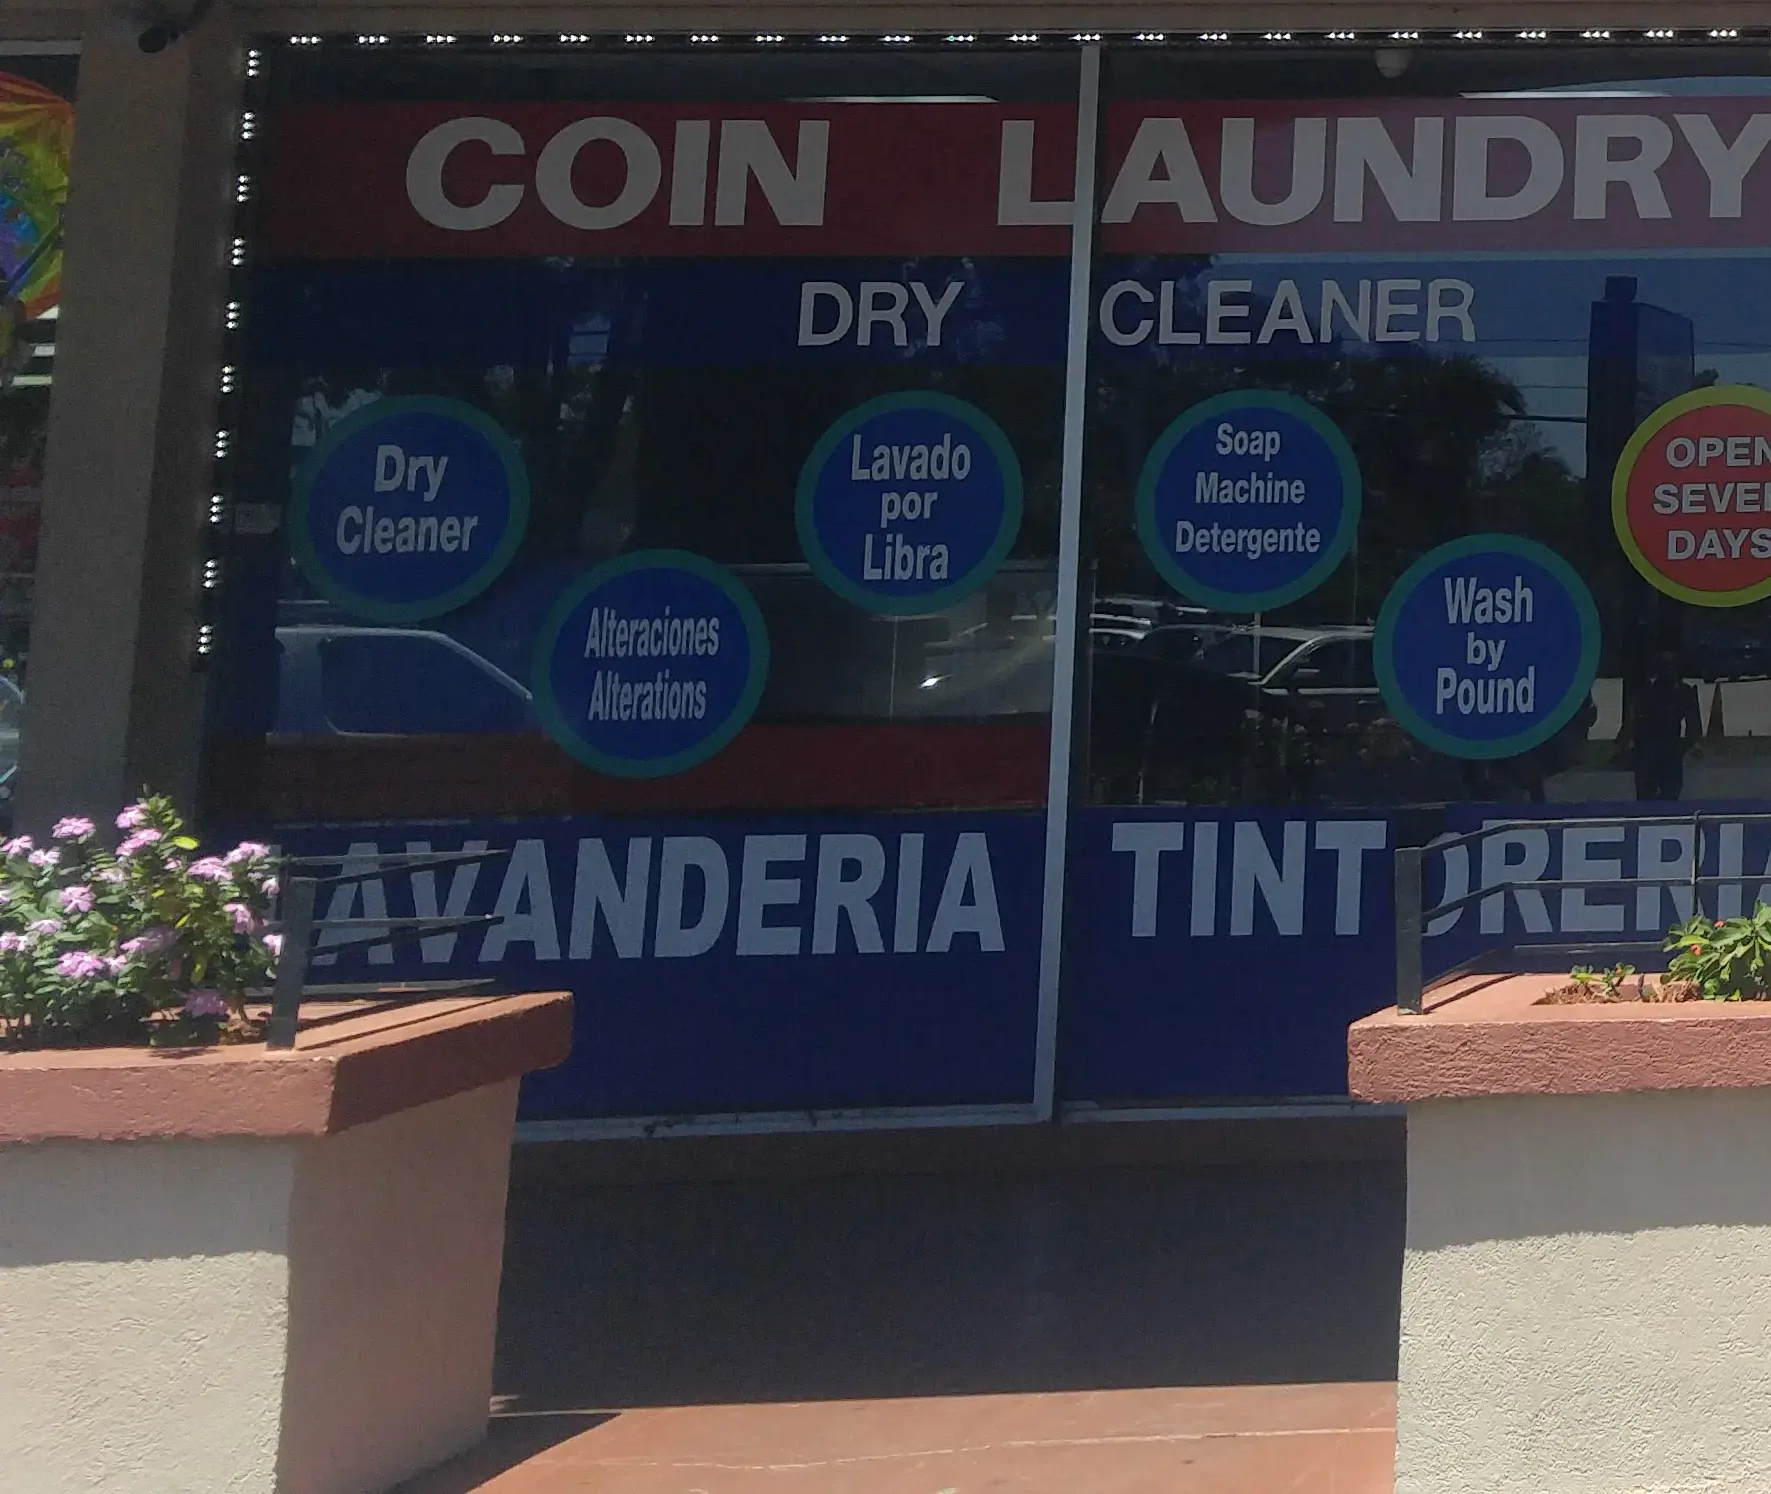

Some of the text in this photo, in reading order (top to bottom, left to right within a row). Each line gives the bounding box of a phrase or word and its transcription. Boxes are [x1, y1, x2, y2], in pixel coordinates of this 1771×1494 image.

[406, 116, 830, 231] COIN
[798, 278, 1476, 347] DRY CLEANER
[851, 433, 971, 482] Lavado
[1216, 421, 1281, 462] Soap
[374, 445, 448, 497] Dry
[1195, 470, 1305, 506] Machine
[336, 505, 477, 554] Cleaner
[880, 489, 937, 528] por
[864, 534, 949, 581] Libra
[1175, 518, 1321, 561] Detergente
[1444, 575, 1533, 624] Wash
[584, 606, 719, 657] Alteraciones
[1466, 633, 1506, 671] by
[588, 668, 706, 721] Alterations
[1435, 666, 1535, 715] Pound
[272, 832, 1006, 966] AVANDERIA
